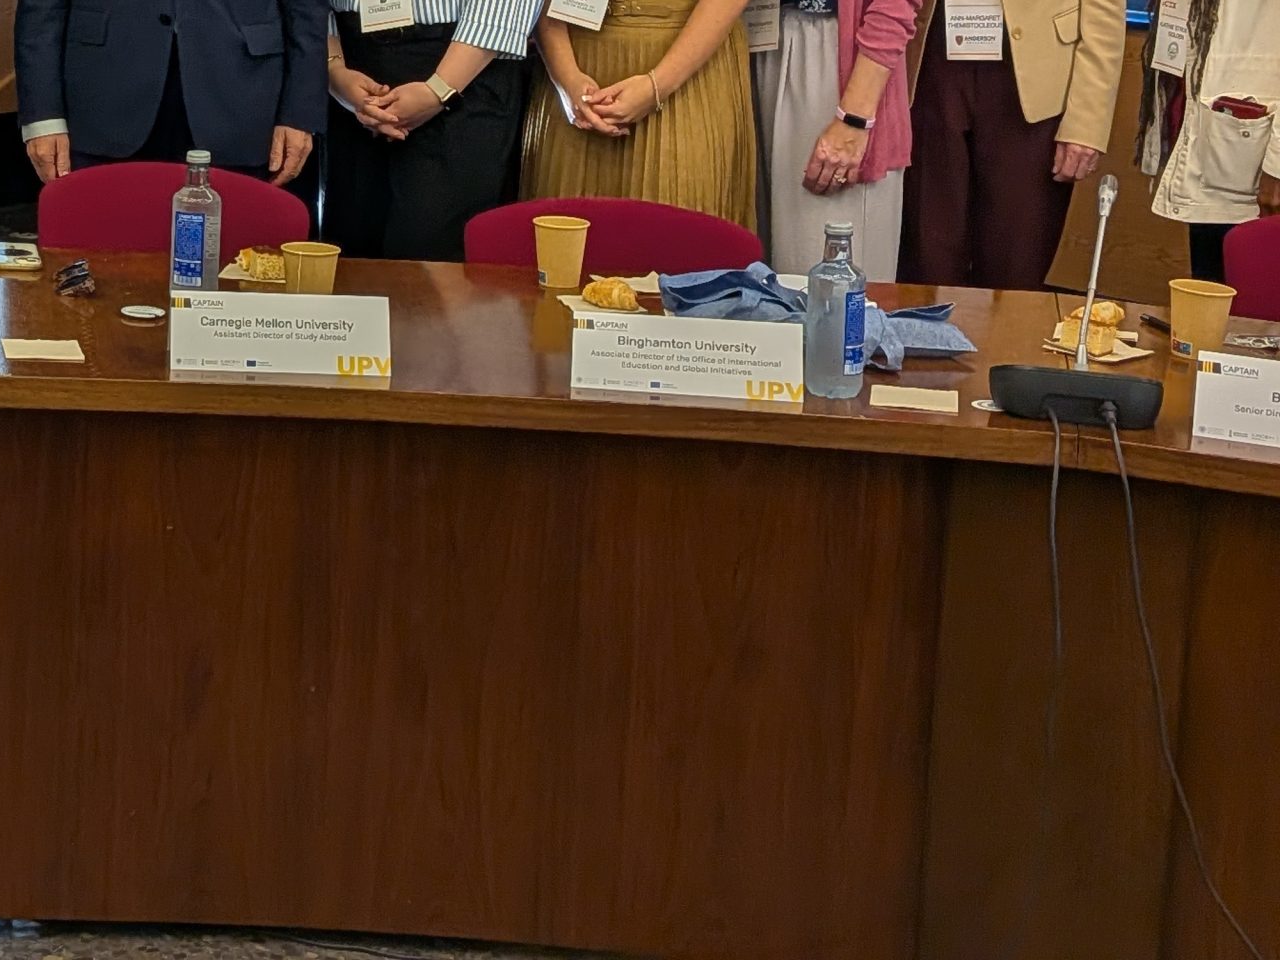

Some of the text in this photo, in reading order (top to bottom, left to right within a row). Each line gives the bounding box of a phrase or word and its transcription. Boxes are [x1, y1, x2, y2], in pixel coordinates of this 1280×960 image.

[192, 299, 224, 307] CAPTAIN
[200, 316, 354, 333] Carnegie Mellon University
[595, 321, 628, 329] CAPTAIN
[214, 331, 251, 339] Assistant
[295, 333, 318, 342] Study
[618, 336, 757, 355] Binghamton University
[591, 350, 781, 367] Associate Director of the Office of International
[337, 355, 391, 376] UPV
[622, 362, 752, 375] Education and Global Initiatives
[1222, 365, 1259, 377] CAPTAIN
[746, 380, 803, 402] UPV
[1234, 405, 1264, 415] Senior
